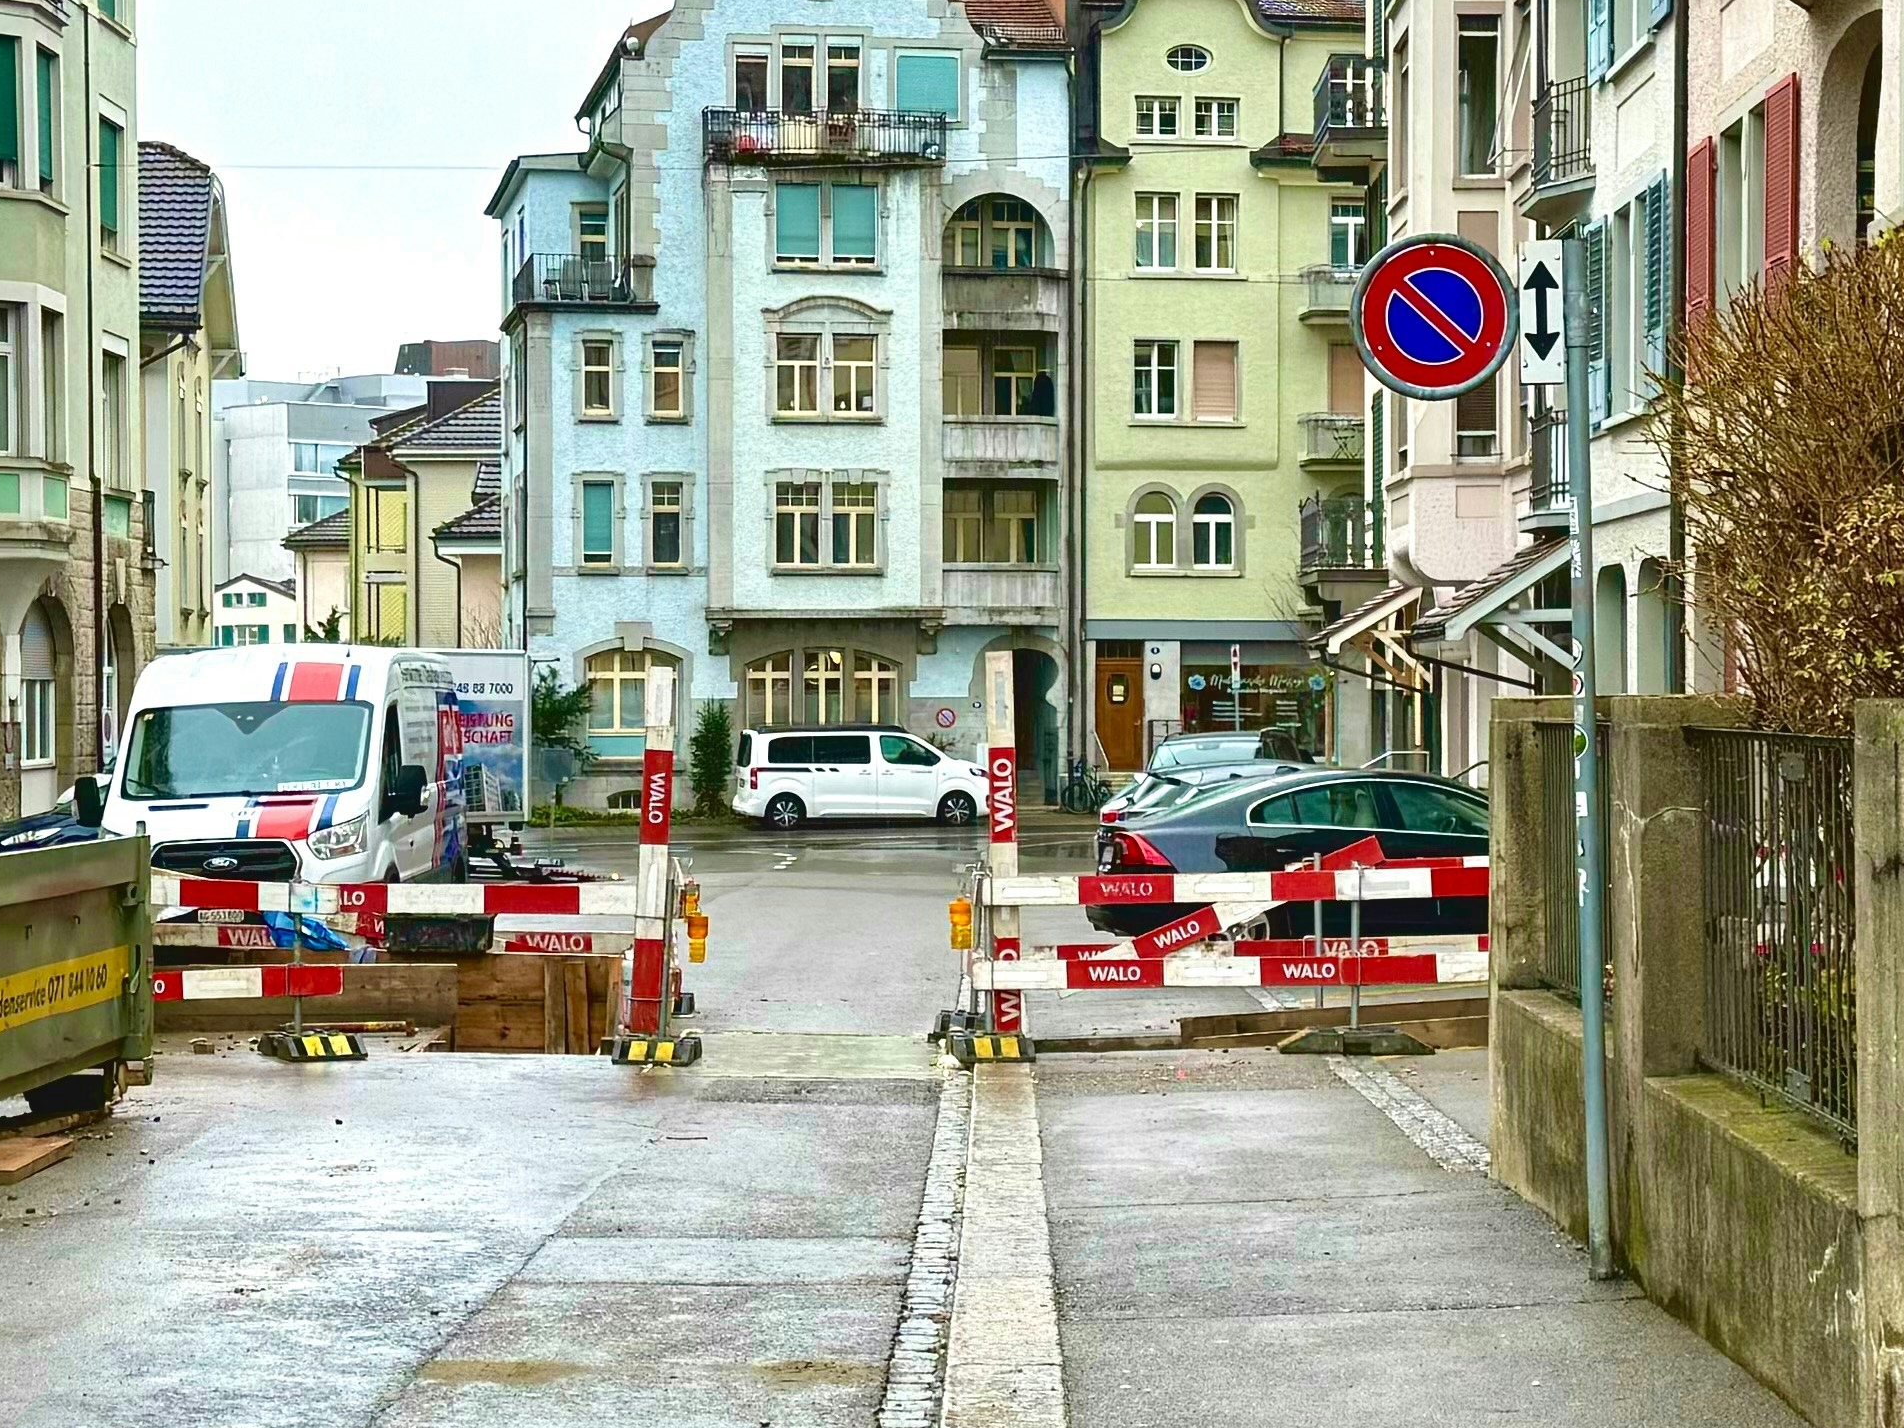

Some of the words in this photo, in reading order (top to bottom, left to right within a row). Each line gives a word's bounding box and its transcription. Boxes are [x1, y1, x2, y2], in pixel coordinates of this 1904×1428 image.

[489, 683, 513, 695] 7000
[460, 713, 514, 728] EISTUNG
[463, 730, 513, 744] SCHAFT
[648, 772, 666, 824] WALO
[992, 758, 1013, 832] WALO
[1100, 882, 1153, 897] WALO
[342, 891, 365, 906] LO
[226, 928, 276, 947] WAL
[525, 933, 585, 952] WALO
[1153, 920, 1200, 949] WALO
[1089, 966, 1141, 981] WALO
[1282, 963, 1335, 979] WALO
[47, 974, 66, 1004] 071
[68, 969, 84, 997] 844
[96, 963, 108, 990] 60
